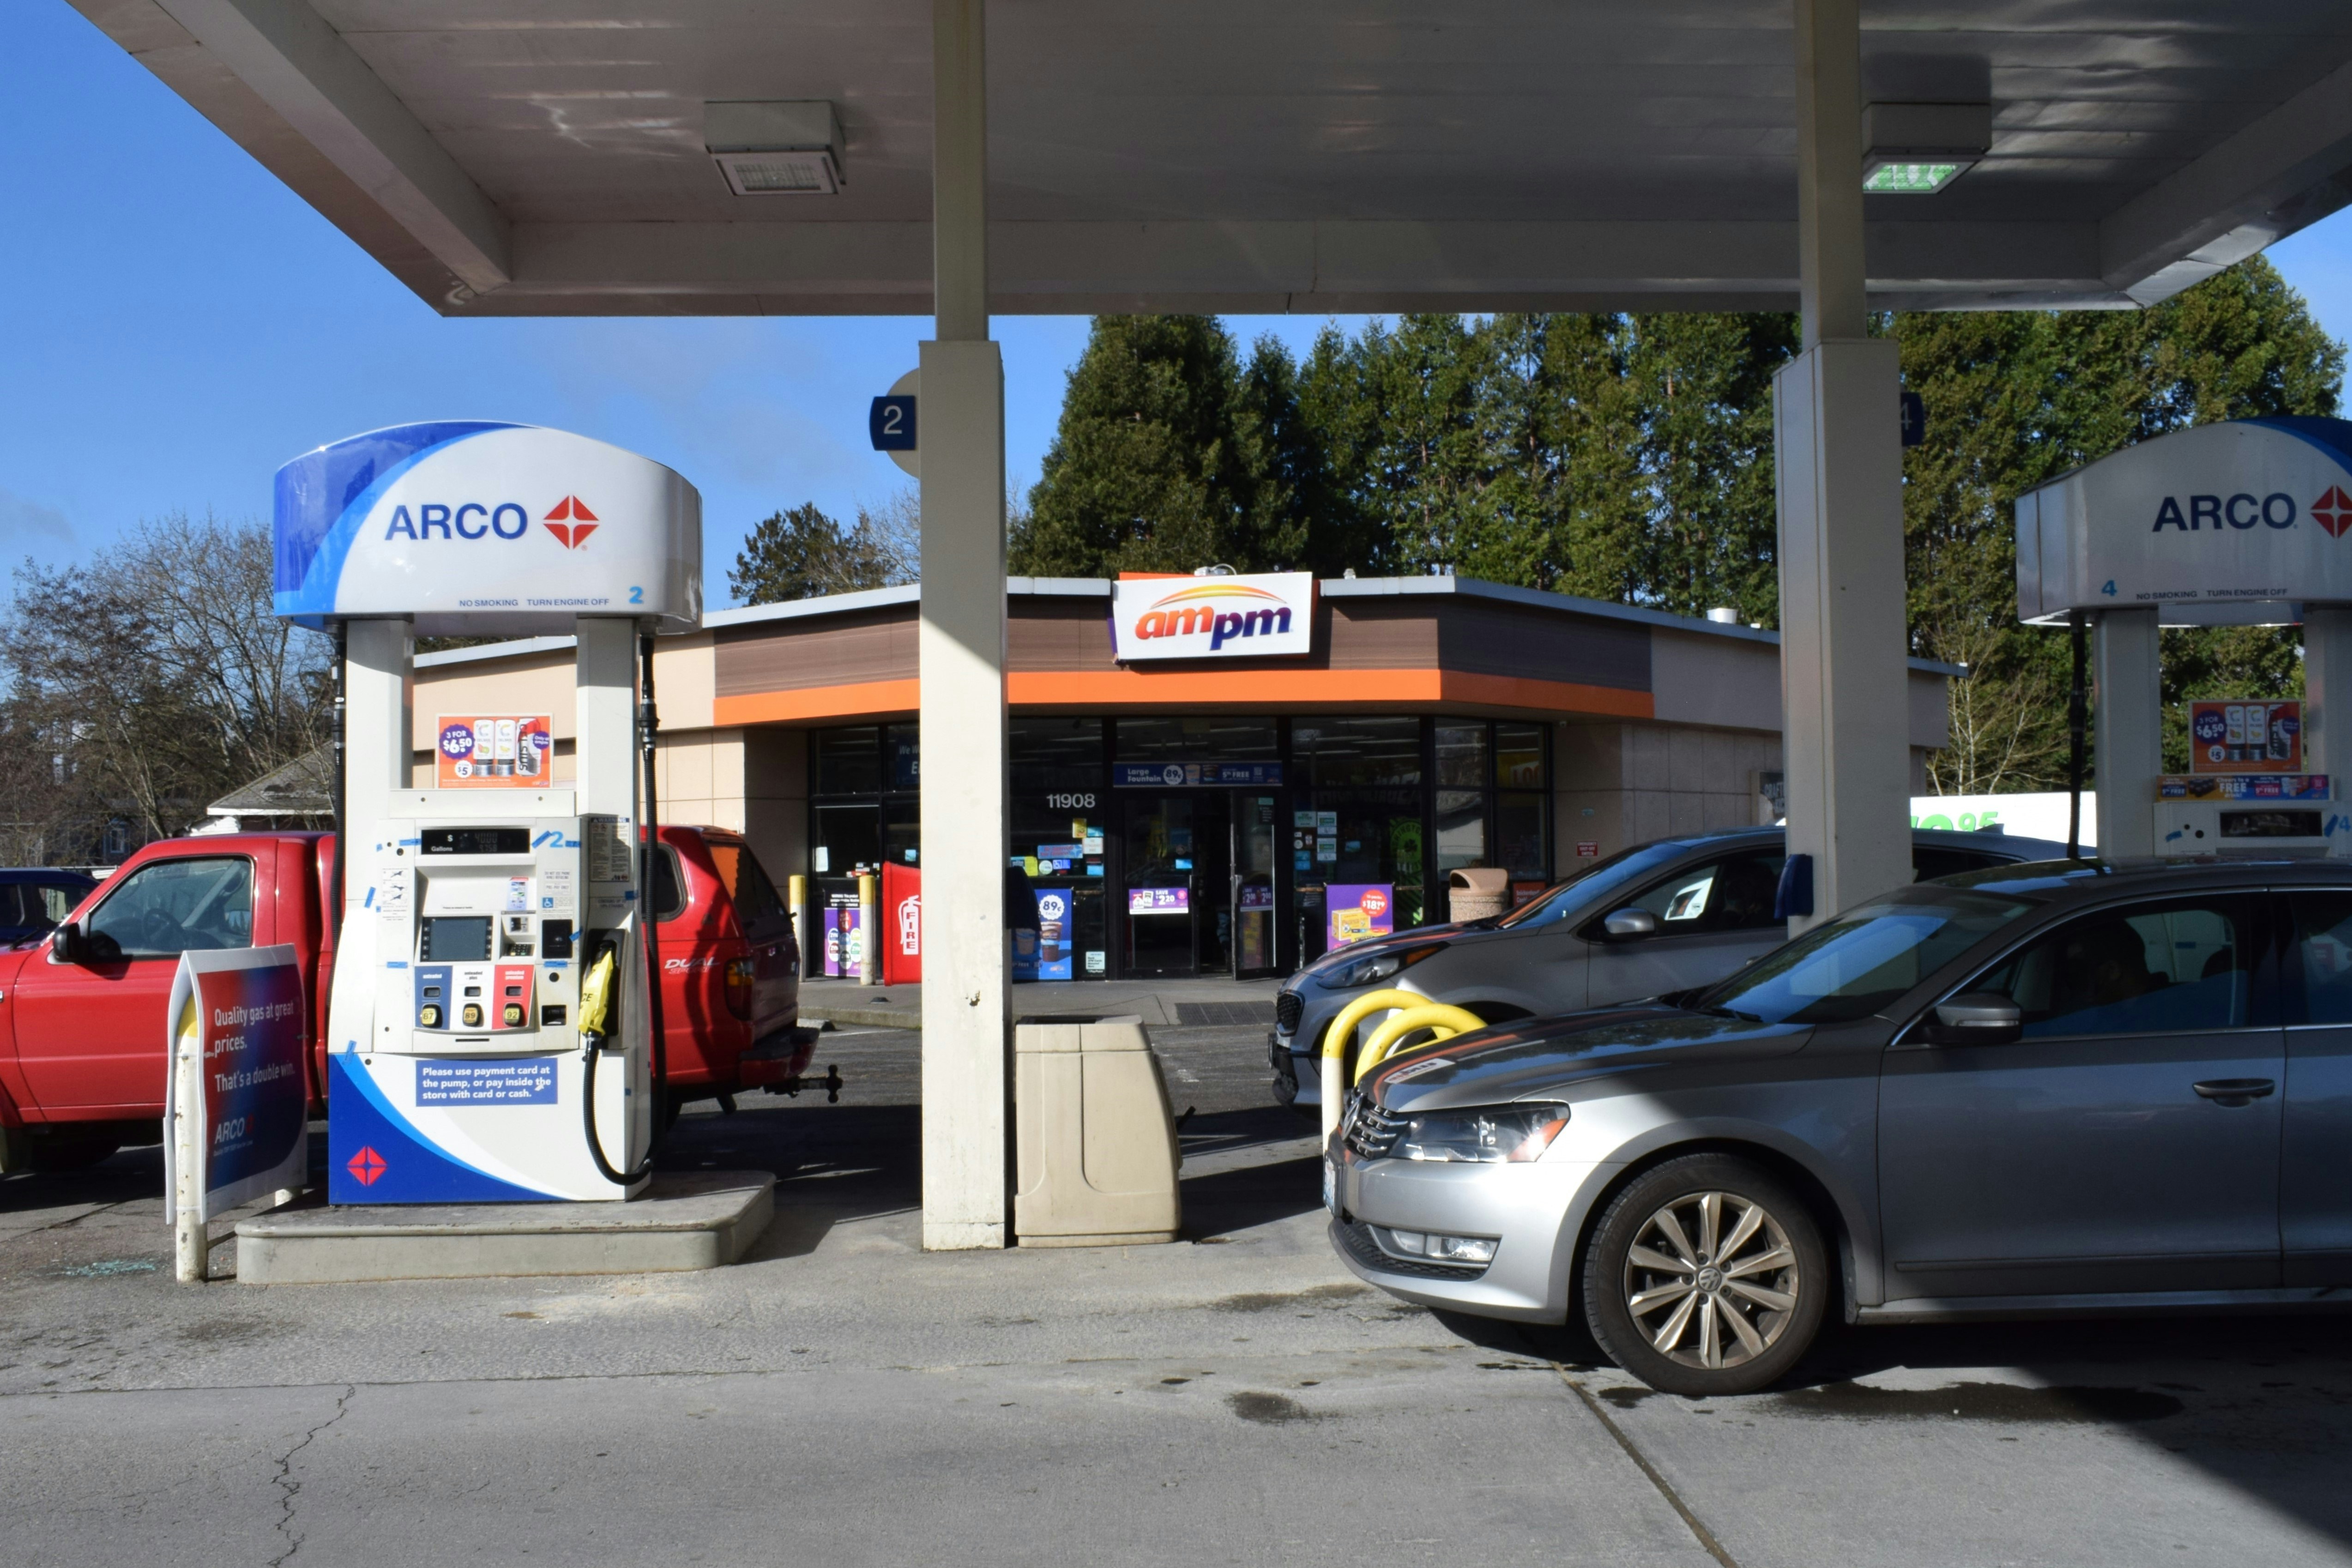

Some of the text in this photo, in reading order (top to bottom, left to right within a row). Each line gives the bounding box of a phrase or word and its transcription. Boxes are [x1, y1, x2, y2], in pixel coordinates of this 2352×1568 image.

[884, 405, 902, 434] 2
[2152, 493, 2297, 532] ARCO
[385, 503, 528, 540] ARCO
[628, 586, 644, 604] 2
[2101, 580, 2117, 597] 4
[2152, 591, 2198, 599] SMOKING
[1135, 606, 1292, 651] ampm
[2211, 751, 2221, 760] $5
[458, 766, 468, 776] $5
[2219, 783, 2247, 793] FREE
[1046, 794, 1095, 808] 11908
[2339, 816, 2351, 831] 4
[549, 832, 563, 848] 2
[1043, 901, 1061, 912] 89¢
[906, 912, 916, 949] FIRE
[664, 957, 721, 969] DUAL
[215, 1000, 294, 1028] Quality gas at great
[422, 1011, 434, 1019] 87
[215, 1035, 247, 1058] prices.
[215, 1061, 295, 1092] That's a double win.
[422, 1068, 452, 1077] Please
[474, 1067, 515, 1078] payment
[518, 1066, 537, 1074] card
[441, 1080, 470, 1089] pump,
[486, 1080, 503, 1089] pay
[506, 1078, 533, 1086] inside
[536, 1078, 551, 1086] the
[422, 1091, 446, 1099] store
[508, 1089, 531, 1097] cash.
[215, 1116, 245, 1144] ARCO
